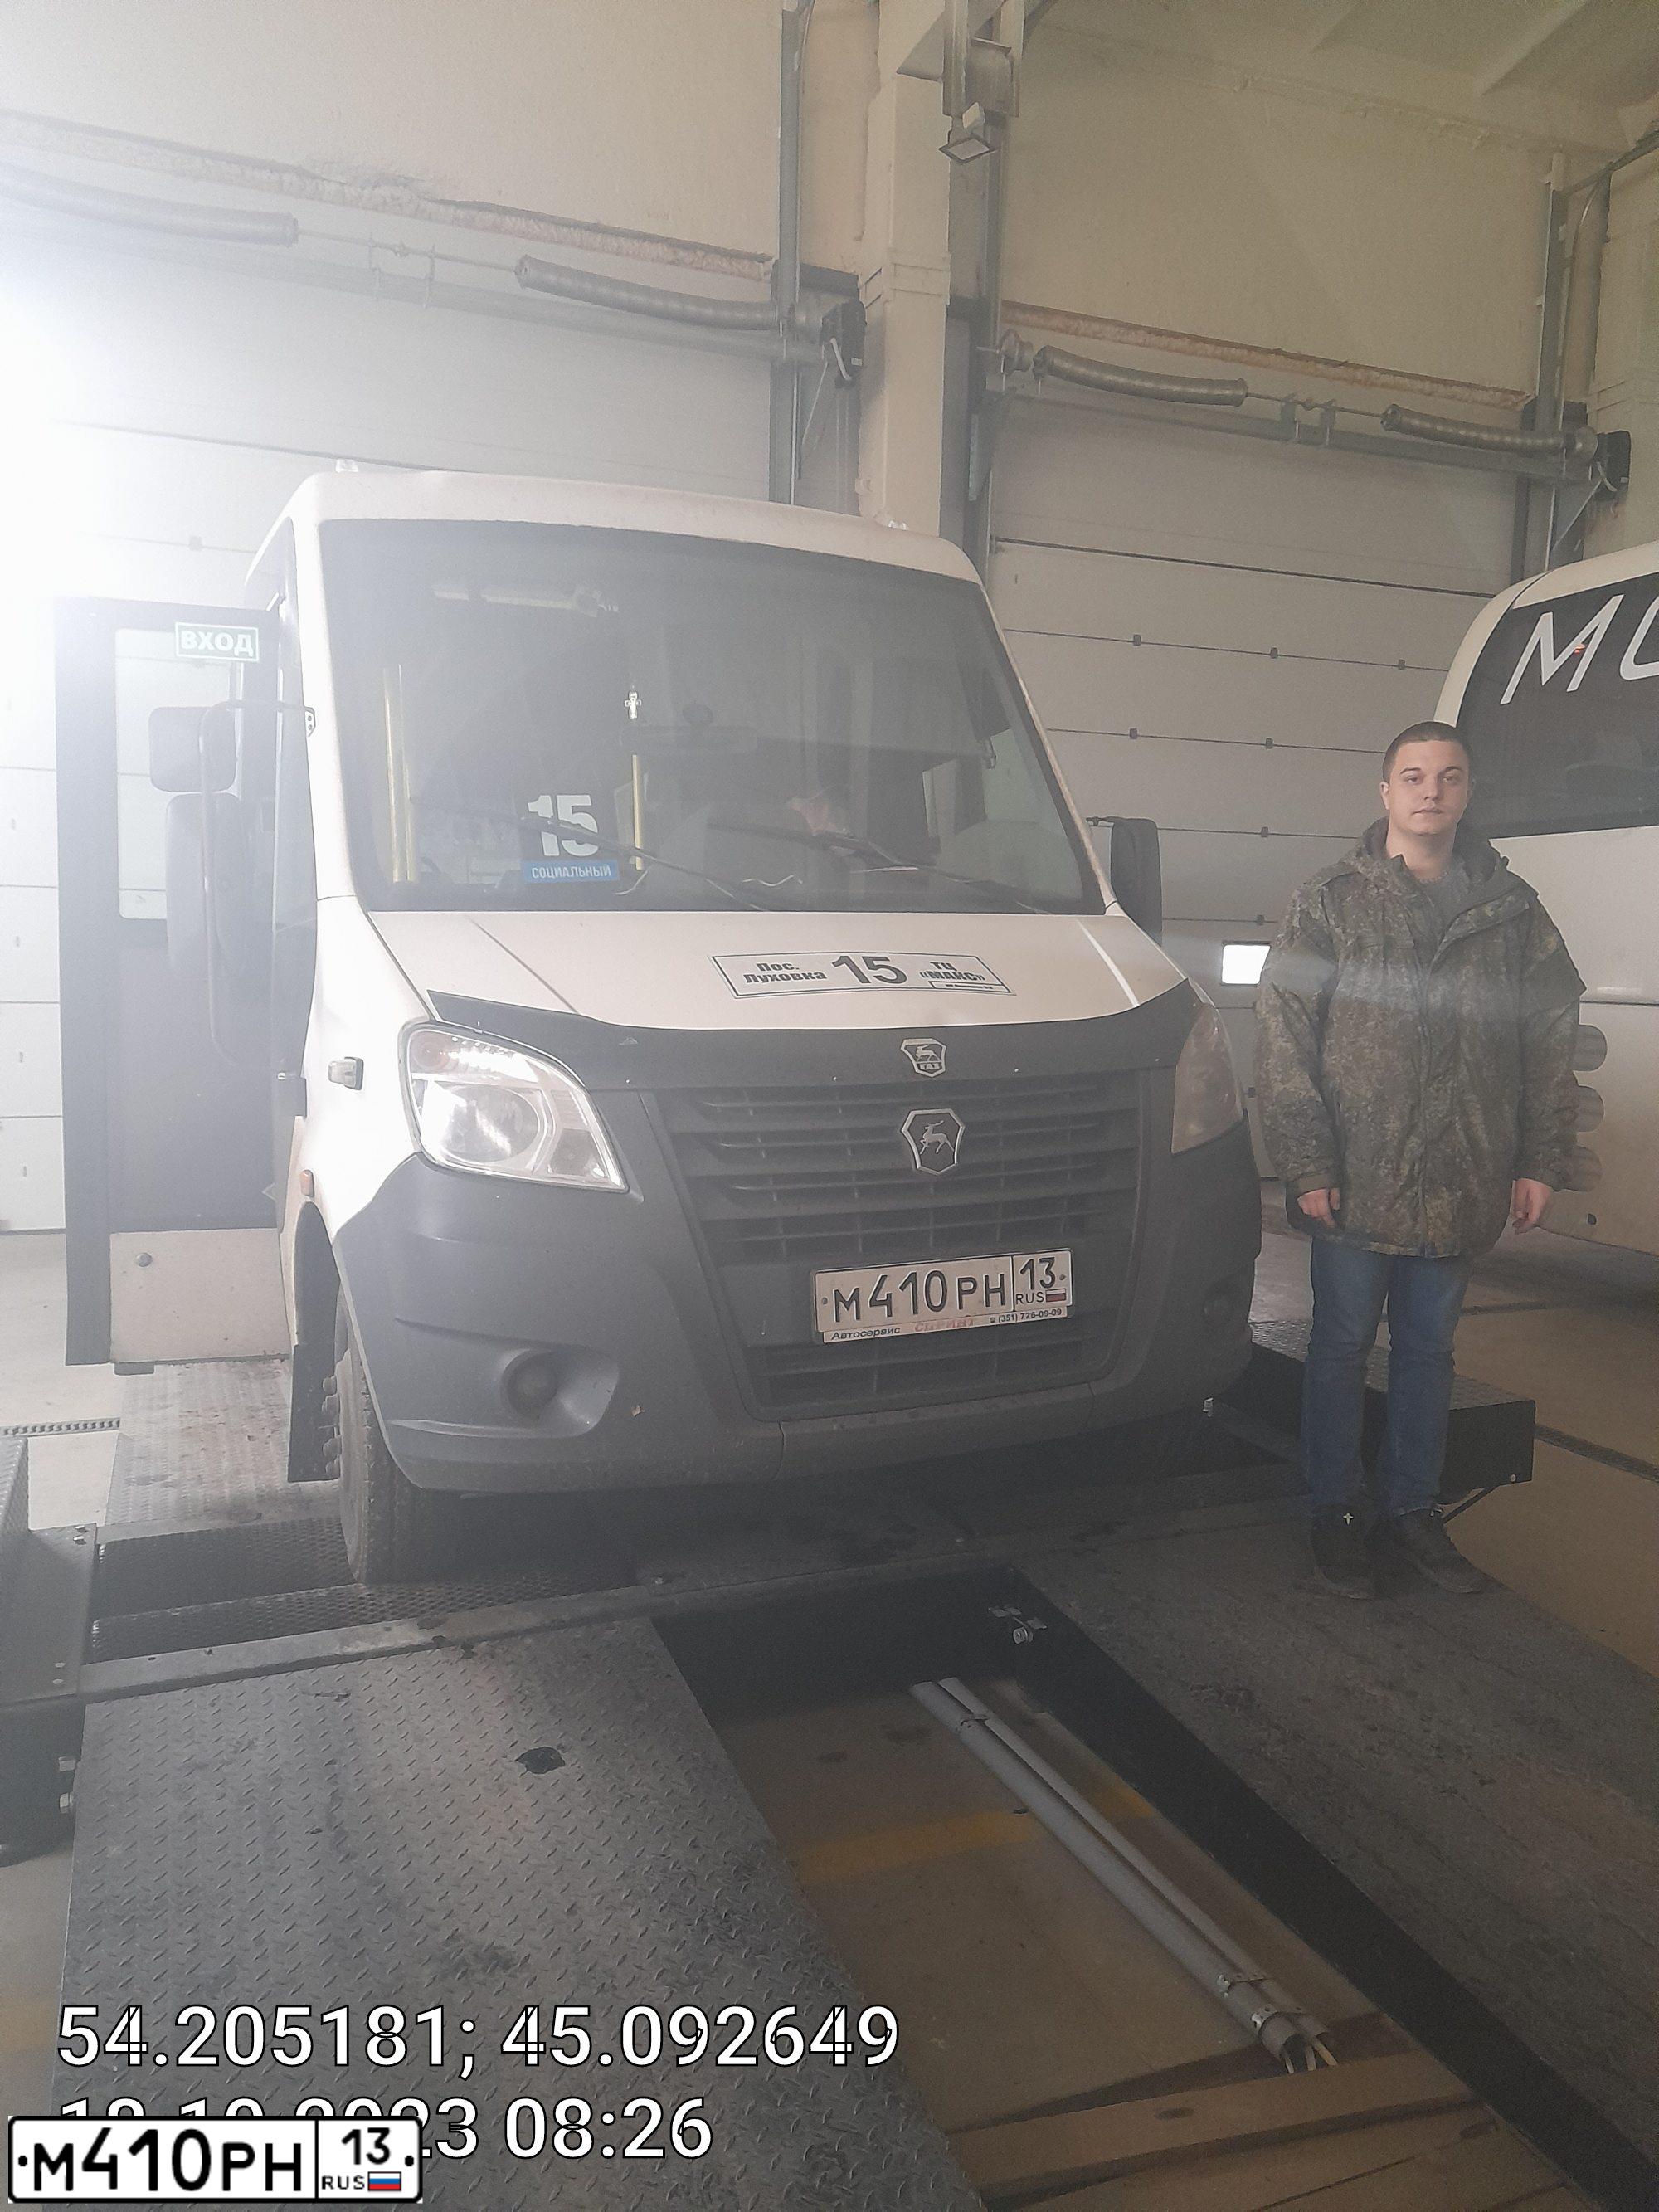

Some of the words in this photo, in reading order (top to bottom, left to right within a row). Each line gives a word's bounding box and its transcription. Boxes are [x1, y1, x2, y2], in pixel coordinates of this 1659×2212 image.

[181, 630, 253, 657] ВХОД
[528, 794, 599, 857] 15
[532, 865, 611, 879] СОЦИАЛЬНЫЙ
[743, 971, 828, 984] Луховка
[756, 962, 800, 972] Пос.
[832, 955, 907, 984] 15
[1019, 1257, 1056, 1289] 13
[1015, 1292, 1044, 1305] RUS
[830, 1327, 901, 1341] Автосервис
[998, 1313, 1018, 1324] (351)
[1020, 1308, 1063, 1320] 726-09-09
